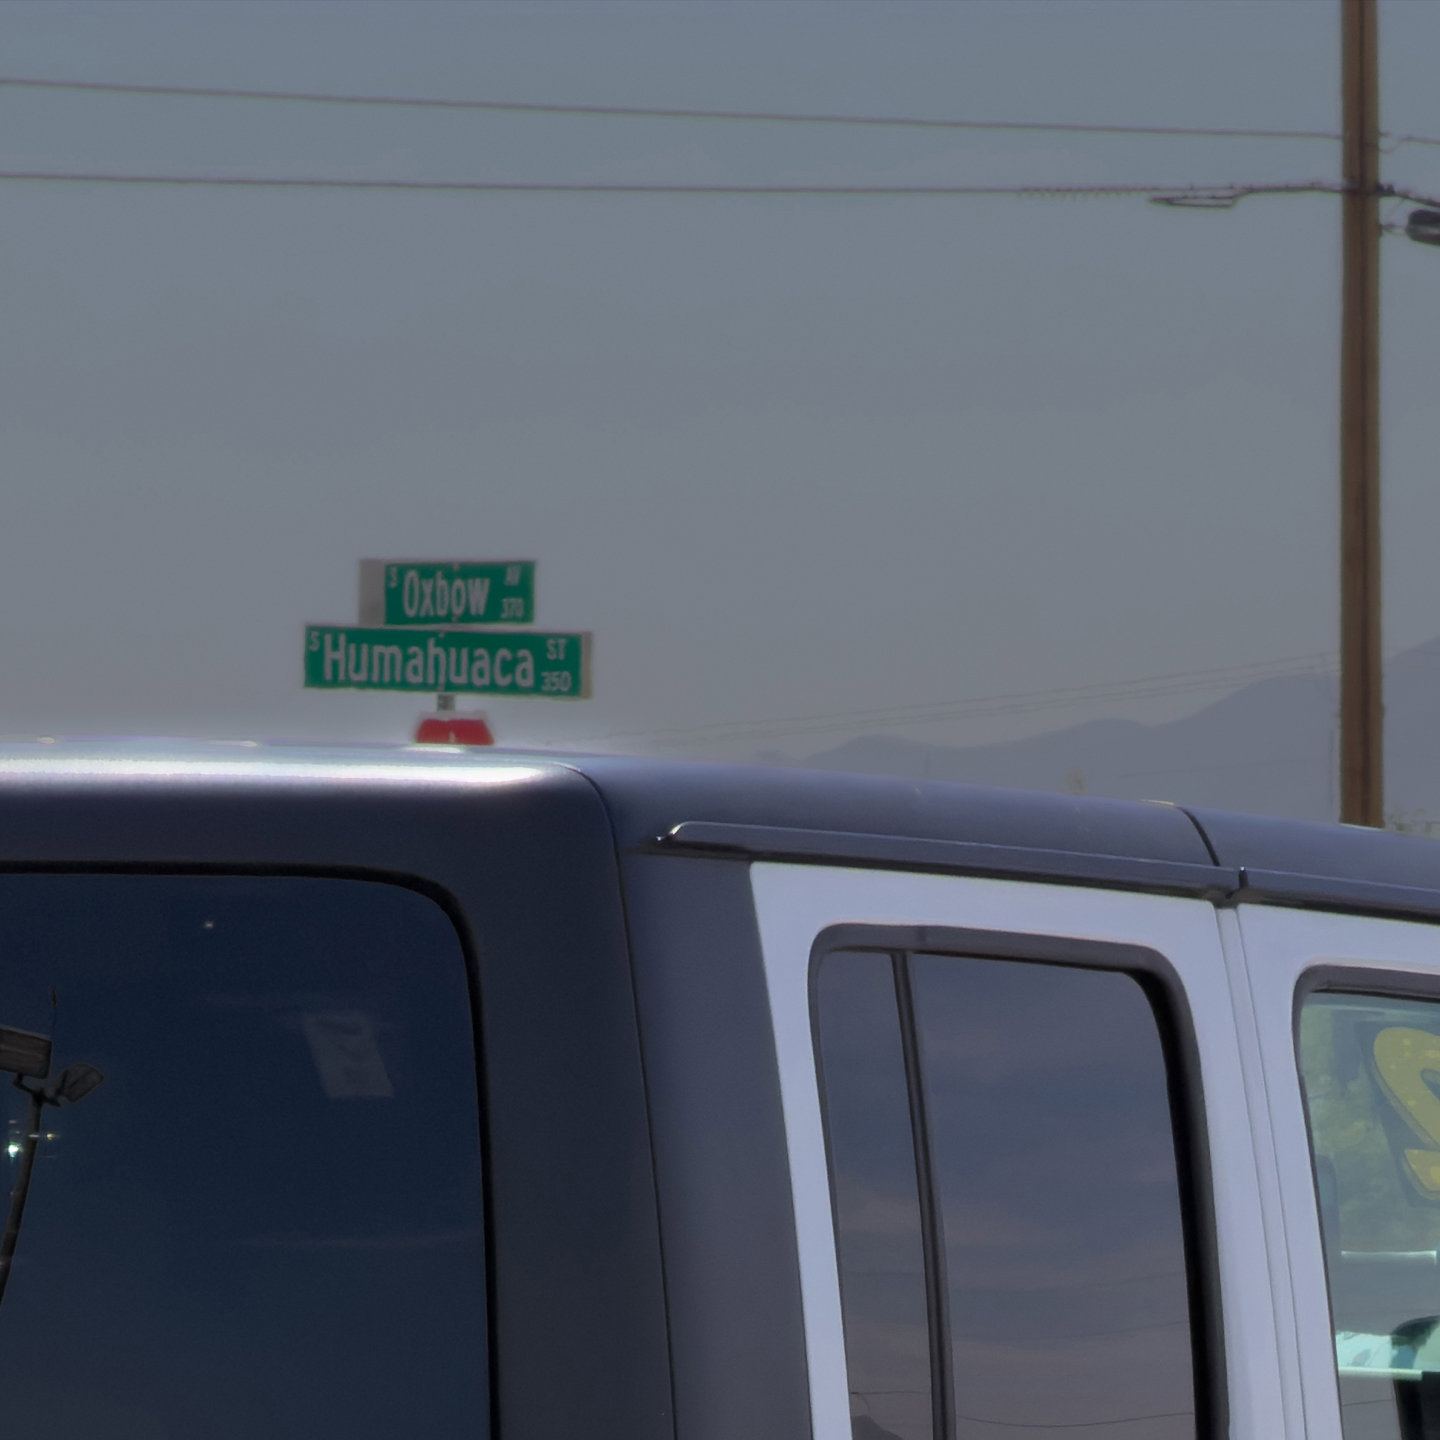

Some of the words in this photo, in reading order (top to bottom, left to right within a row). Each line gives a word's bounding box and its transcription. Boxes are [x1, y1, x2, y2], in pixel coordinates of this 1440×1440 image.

[402, 569, 491, 619] Oxbow
[323, 633, 535, 687] Humahuaca
[546, 638, 568, 660] ST
[541, 671, 572, 692] 350
